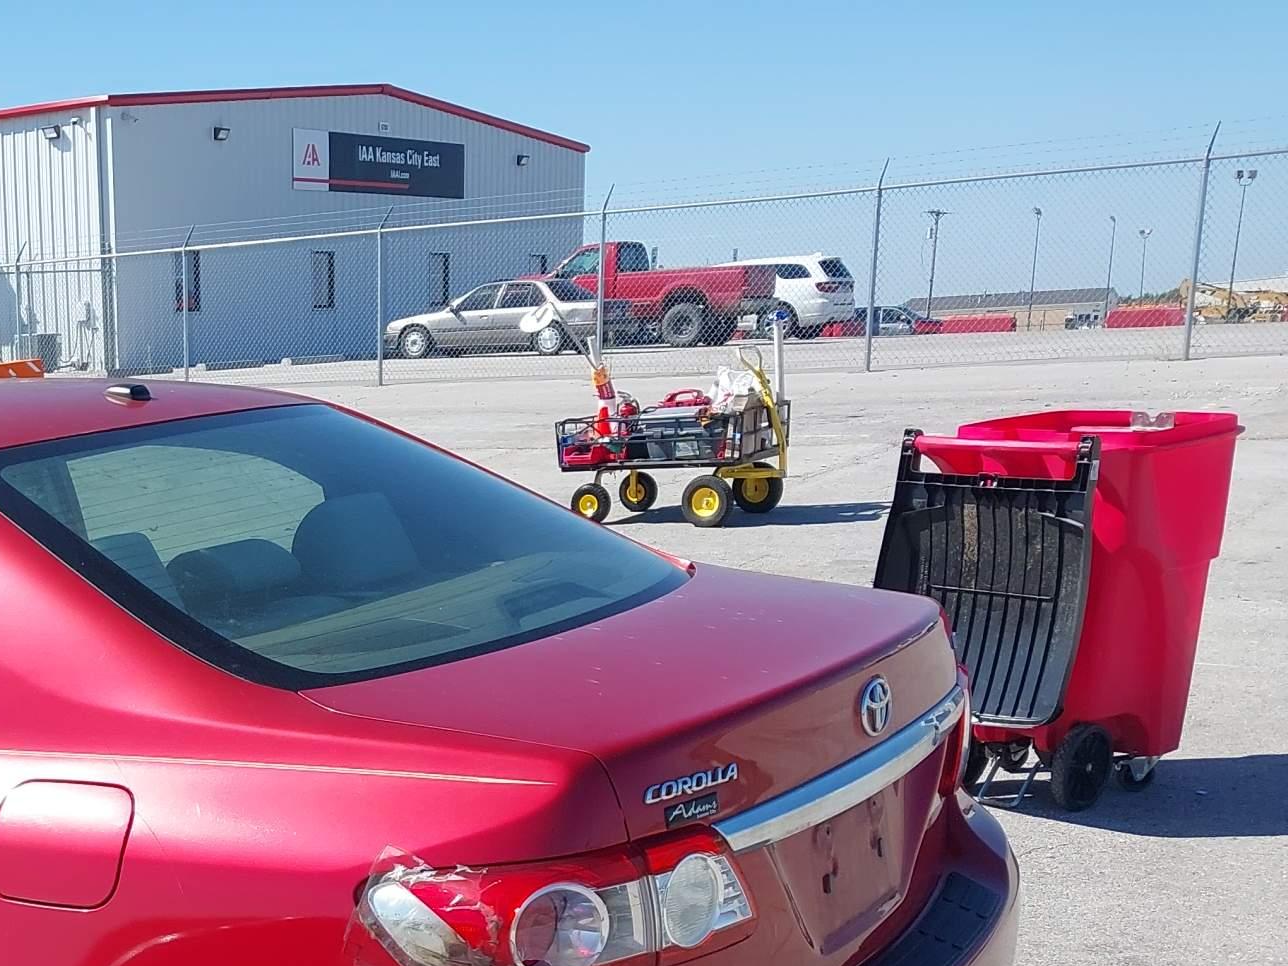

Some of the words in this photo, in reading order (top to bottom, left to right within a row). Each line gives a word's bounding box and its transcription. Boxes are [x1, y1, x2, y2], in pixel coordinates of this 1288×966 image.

[358, 145, 374, 162] IAA
[376, 148, 405, 165] Kansas
[406, 149, 422, 168] City
[423, 151, 440, 167] East
[645, 762, 738, 805] COROLLA
[668, 799, 718, 822] Adams
